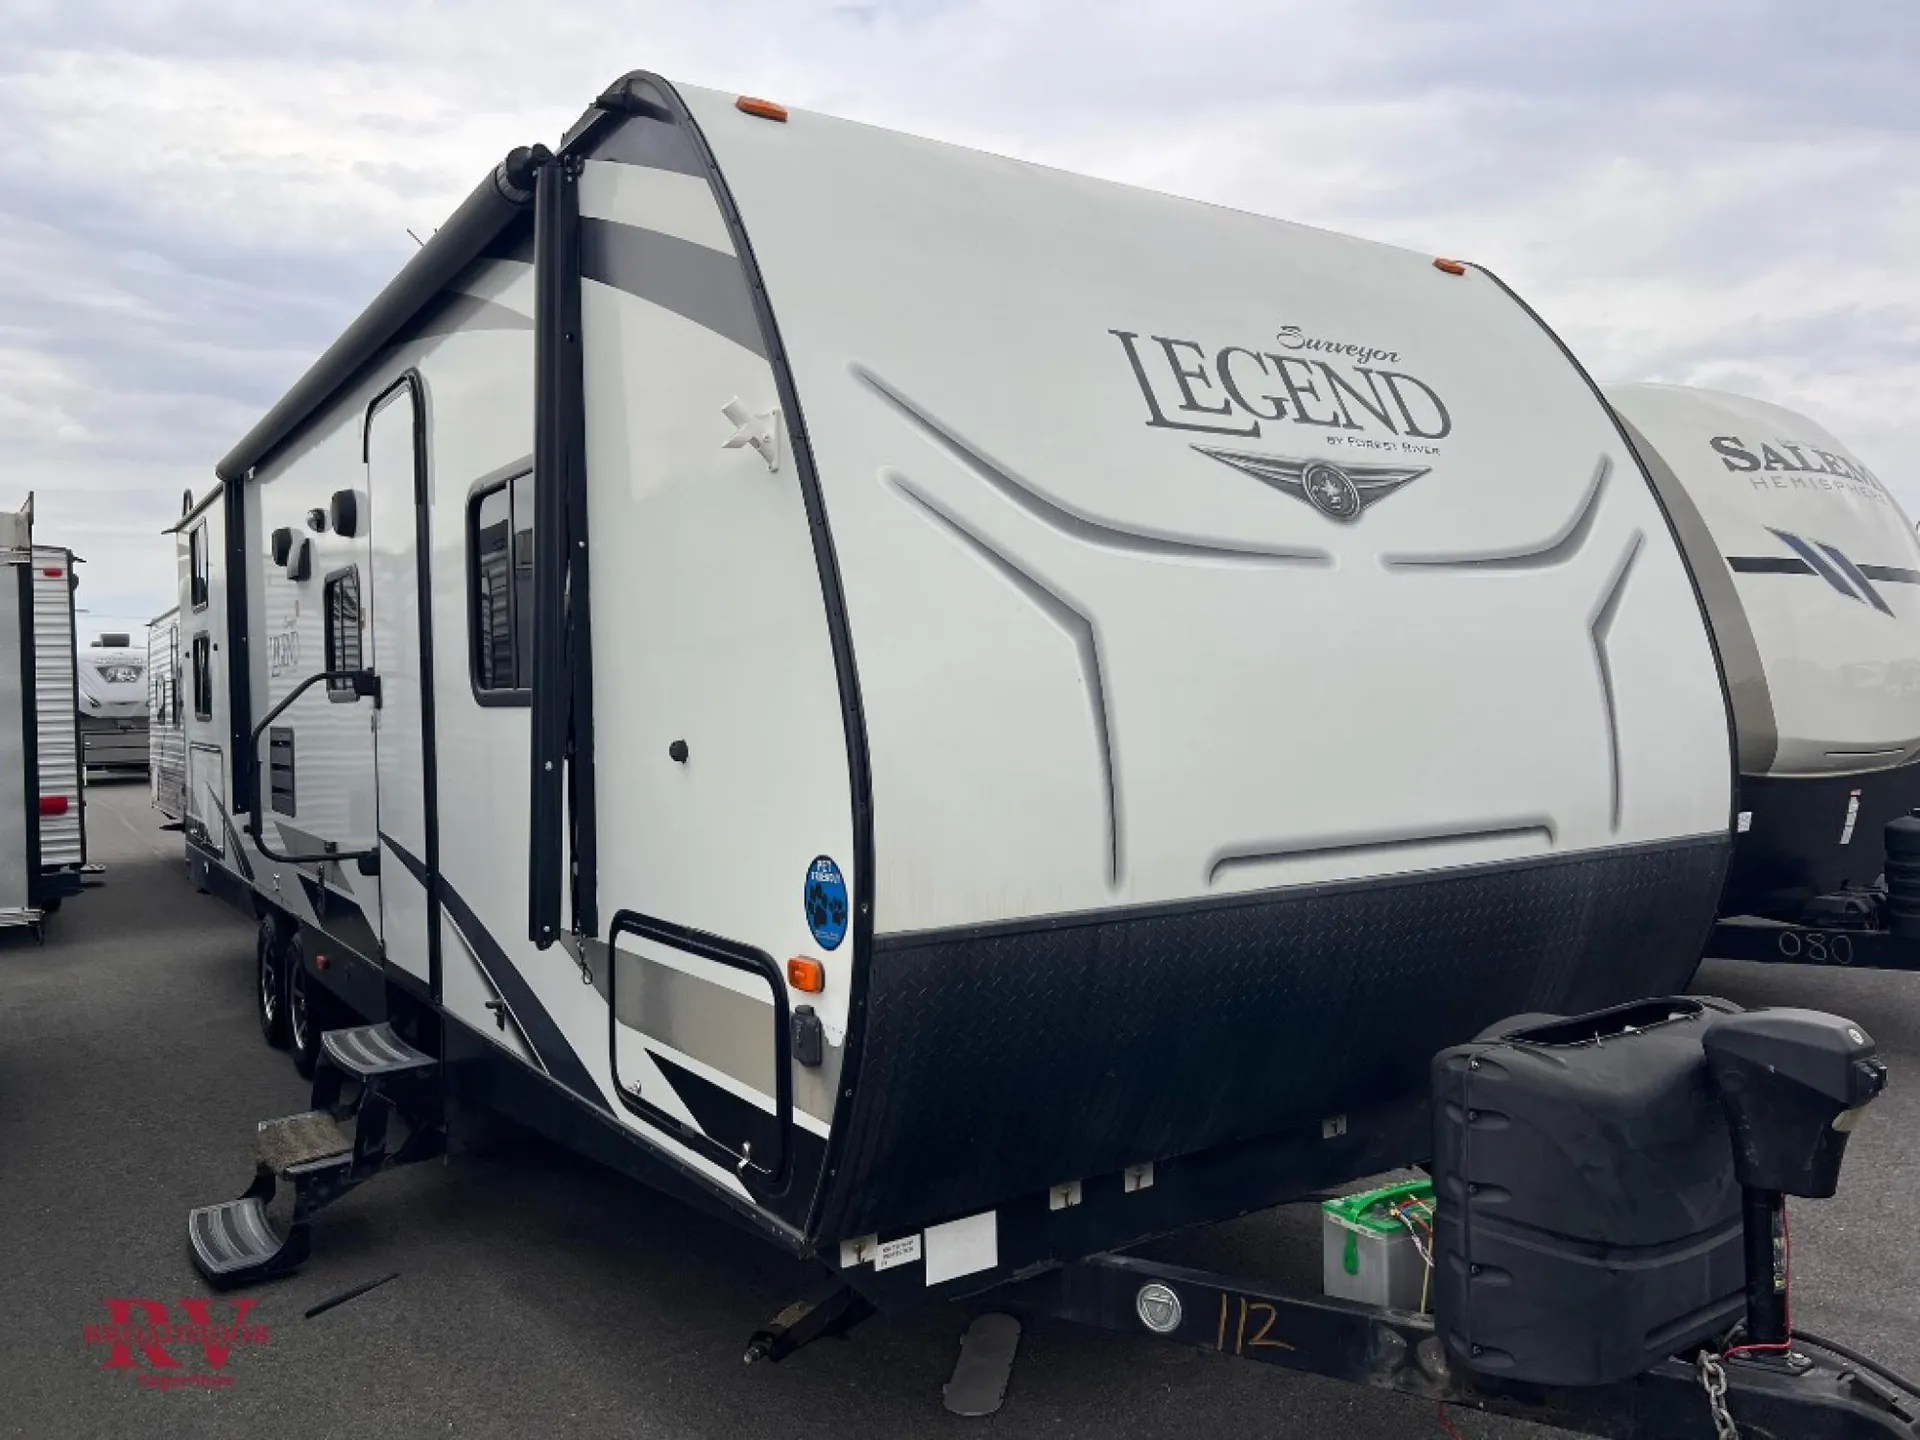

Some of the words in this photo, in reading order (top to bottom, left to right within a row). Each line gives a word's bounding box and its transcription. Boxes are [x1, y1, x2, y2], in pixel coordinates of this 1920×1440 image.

[1276, 325, 1402, 364] Surveyor
[1107, 328, 1452, 439] LEGEND
[1326, 435, 1343, 445] BY
[1347, 436, 1398, 451] FOREST
[1402, 441, 1441, 456] RIVER
[1709, 435, 1884, 491] SALEM
[817, 860, 831, 873] PET
[1778, 931, 1853, 965] 080
[1216, 1291, 1297, 1355] 112
